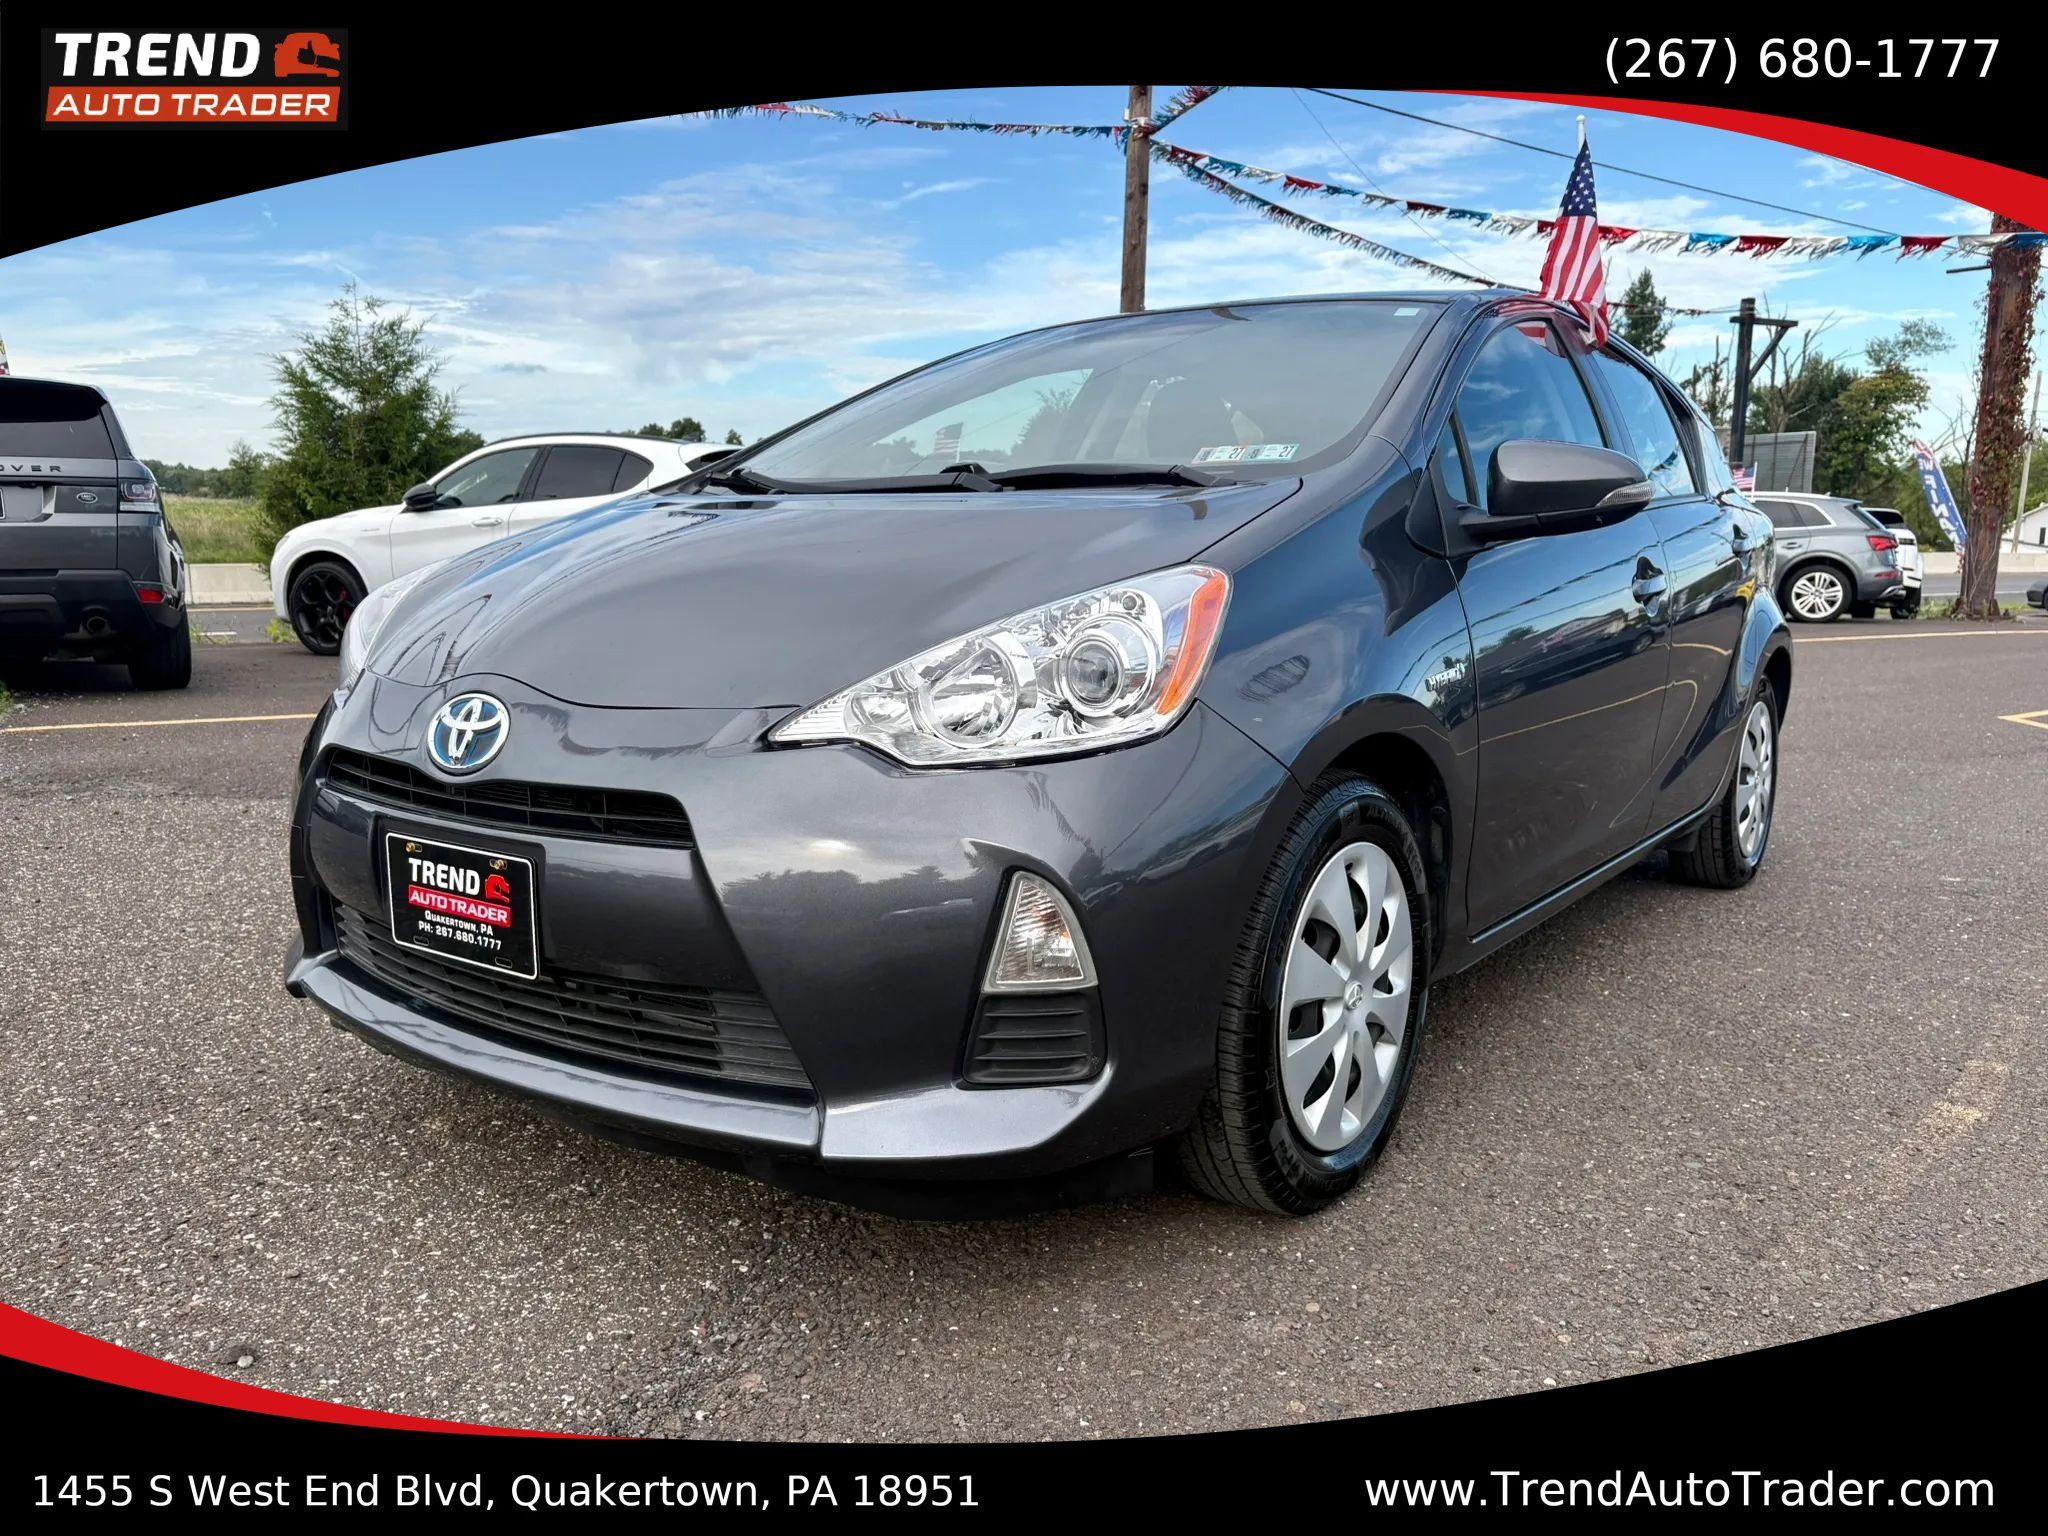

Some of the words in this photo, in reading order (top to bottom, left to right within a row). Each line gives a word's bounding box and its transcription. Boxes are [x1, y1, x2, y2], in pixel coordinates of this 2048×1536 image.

[409, 858, 480, 895] TREND
[410, 891, 447, 909] AUTO
[449, 898, 508, 923] TRADER
[419, 921, 434, 933] PH:
[436, 925, 502, 950] 267.680.1777
[480, 923, 494, 936] PA
